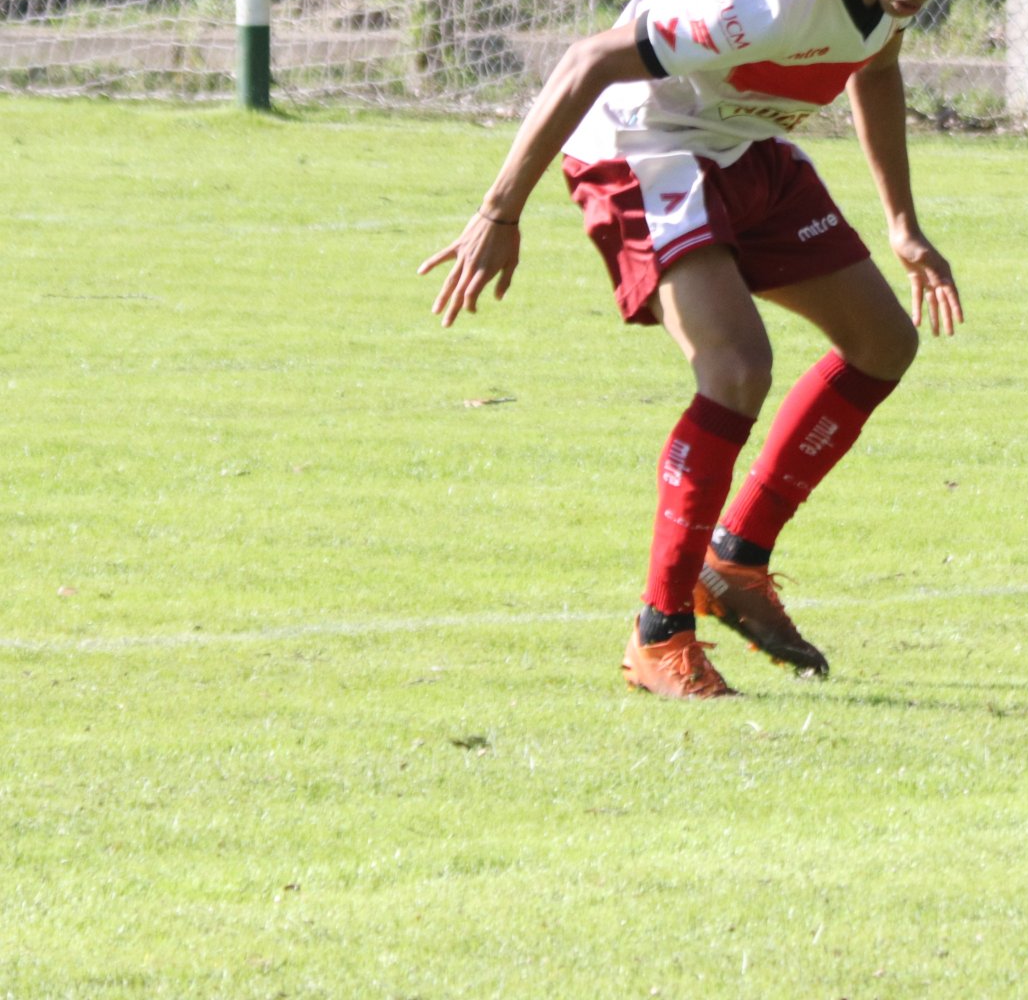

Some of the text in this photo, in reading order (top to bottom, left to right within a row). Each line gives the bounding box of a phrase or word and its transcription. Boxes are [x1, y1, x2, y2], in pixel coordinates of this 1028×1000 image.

[797, 212, 840, 242] mitre
[798, 415, 838, 457] mitre
[662, 439, 691, 488] mitre
